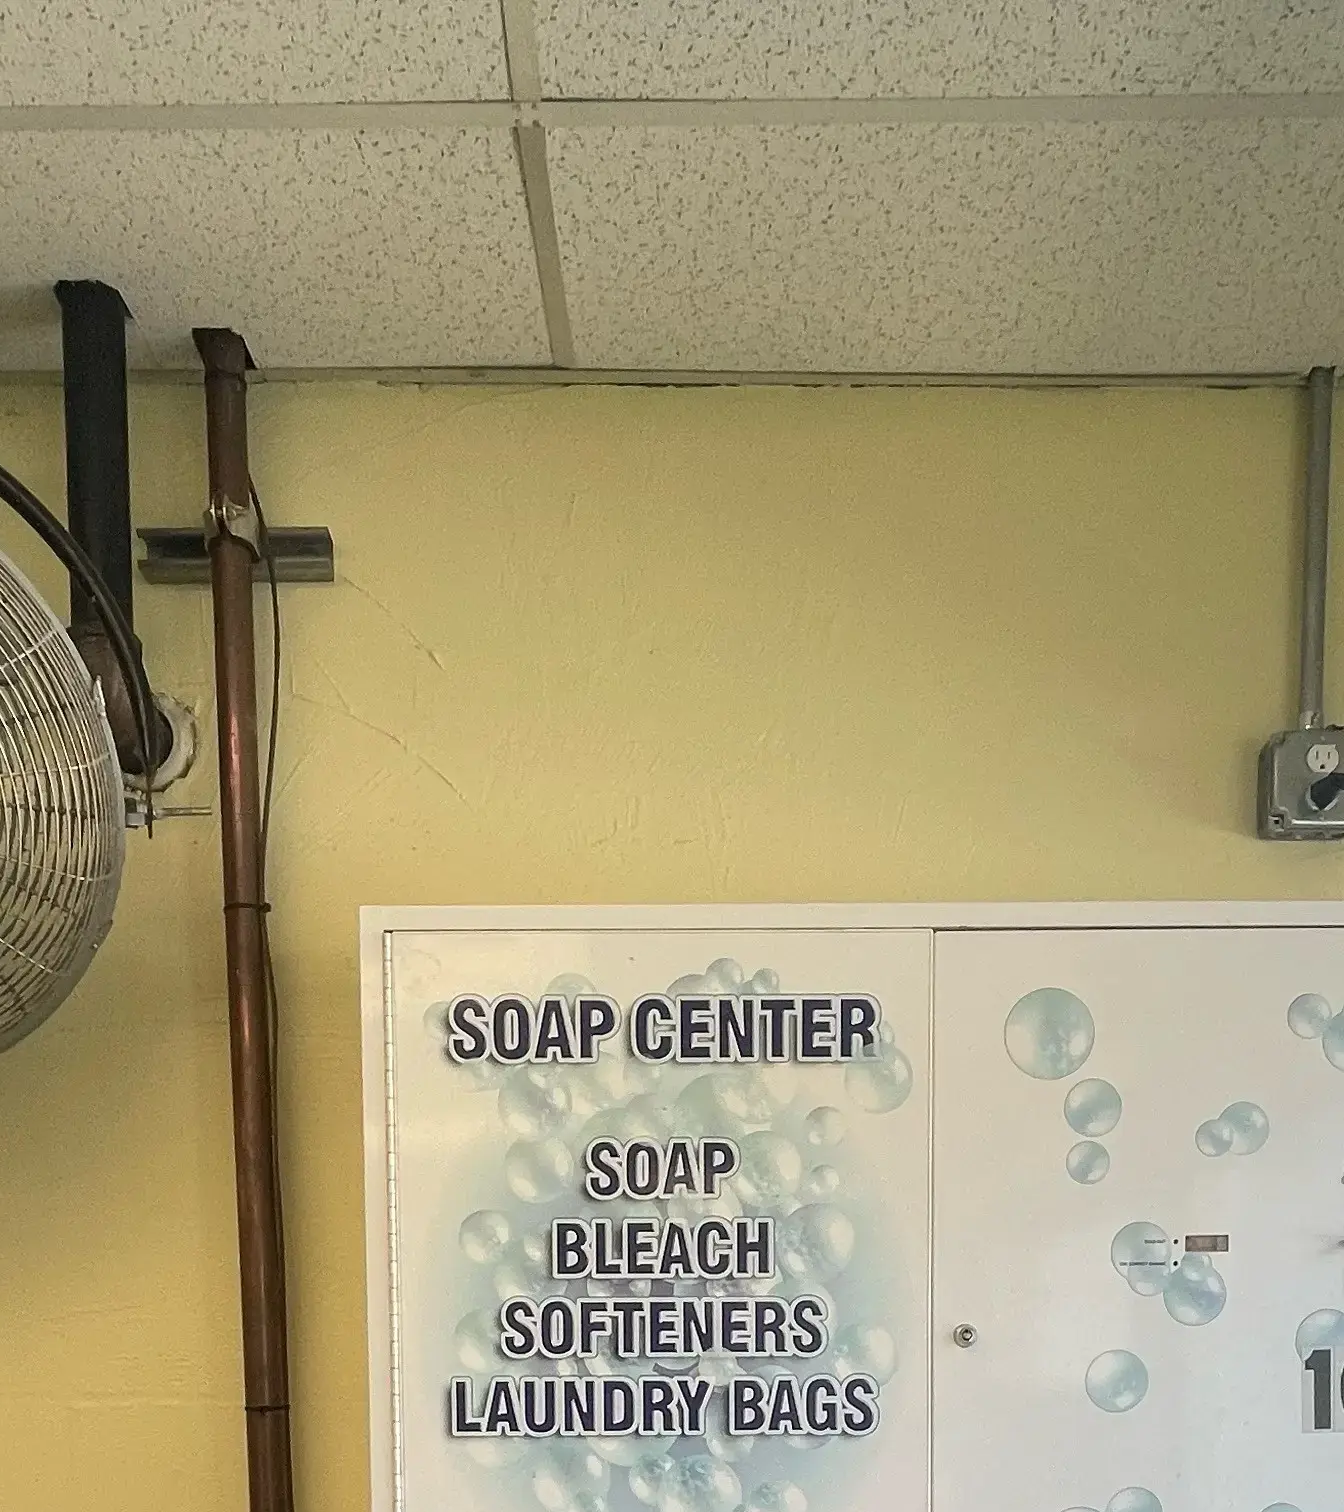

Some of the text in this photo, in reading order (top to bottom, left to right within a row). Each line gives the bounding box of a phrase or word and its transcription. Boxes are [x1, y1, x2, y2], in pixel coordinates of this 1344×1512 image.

[449, 996, 881, 1061] SOAP CENTER
[587, 1140, 737, 1198] SOAP
[553, 1220, 774, 1276] BLEACH
[501, 1298, 827, 1356] SOFTENERS
[452, 1378, 878, 1435] LAUNDRY BAGS
